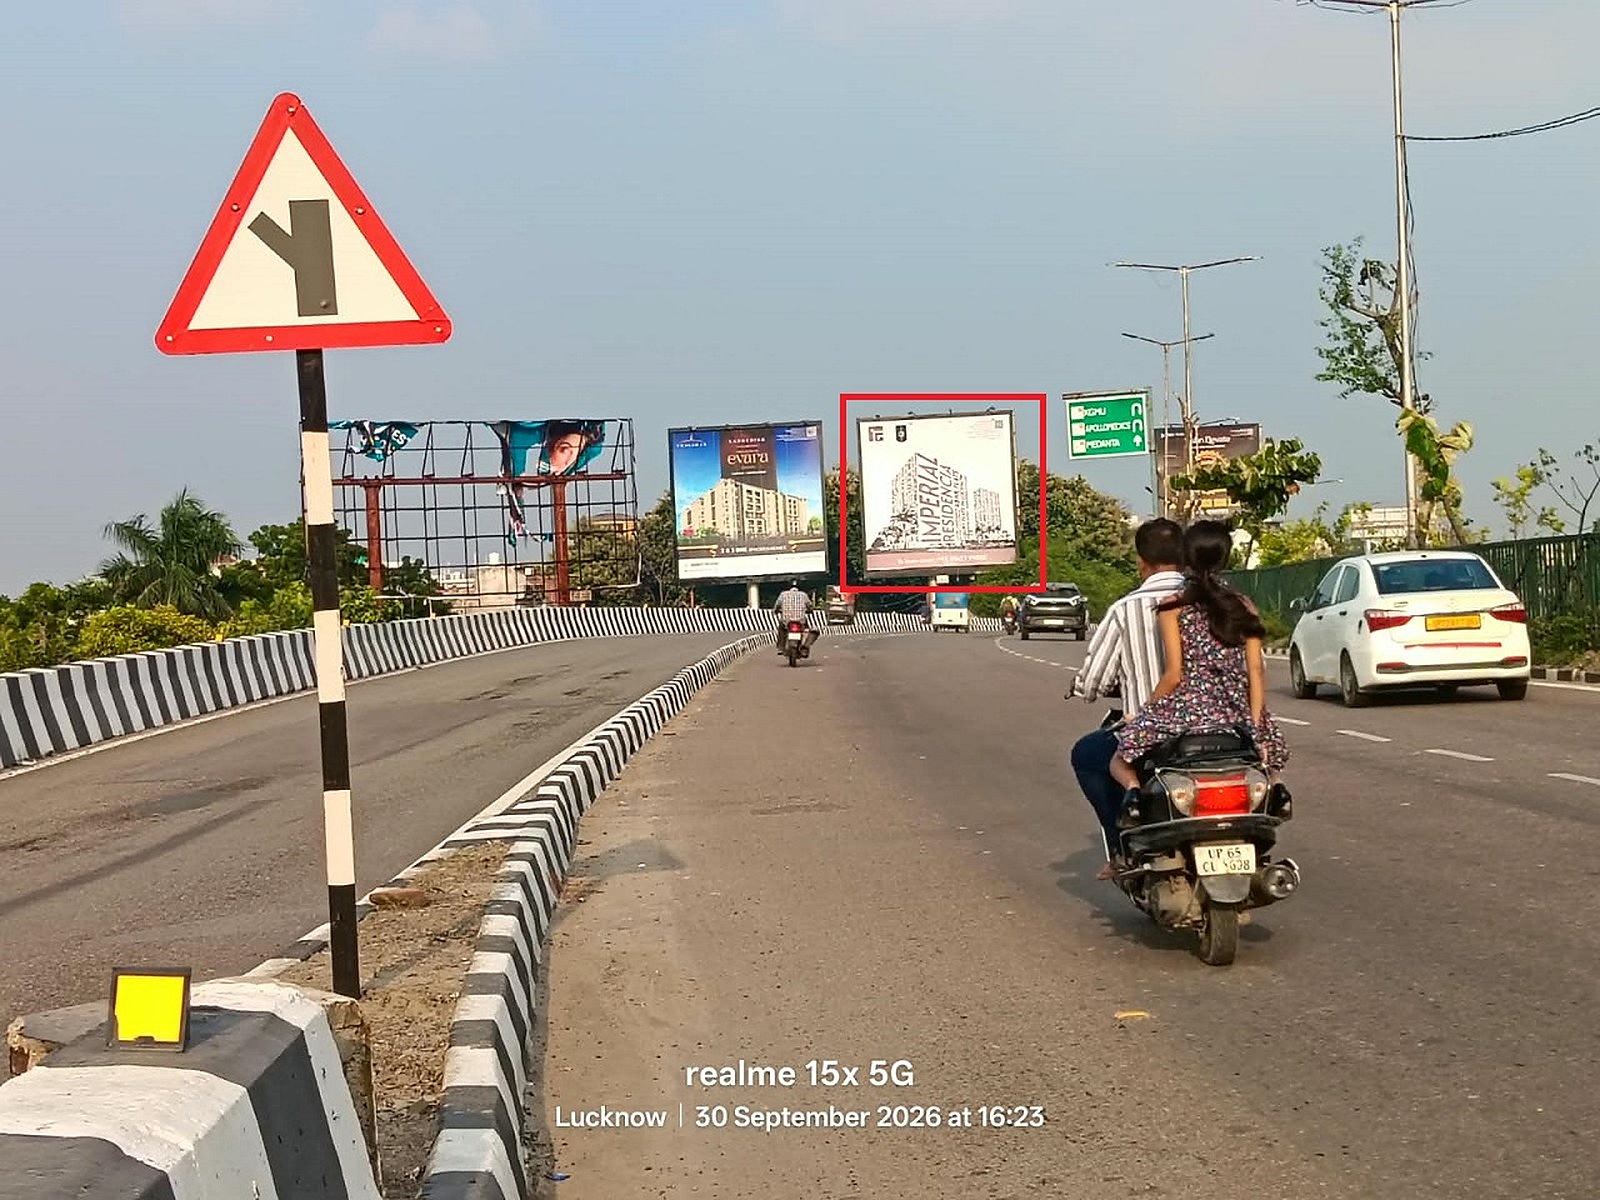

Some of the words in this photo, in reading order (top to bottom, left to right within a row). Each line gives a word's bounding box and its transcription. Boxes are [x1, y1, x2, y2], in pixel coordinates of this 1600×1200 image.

[916, 452, 941, 542] IMPERIAL
[940, 464, 955, 542] RESIDENCIA
[1208, 848, 1223, 859] UP
[1227, 847, 1241, 858] 65
